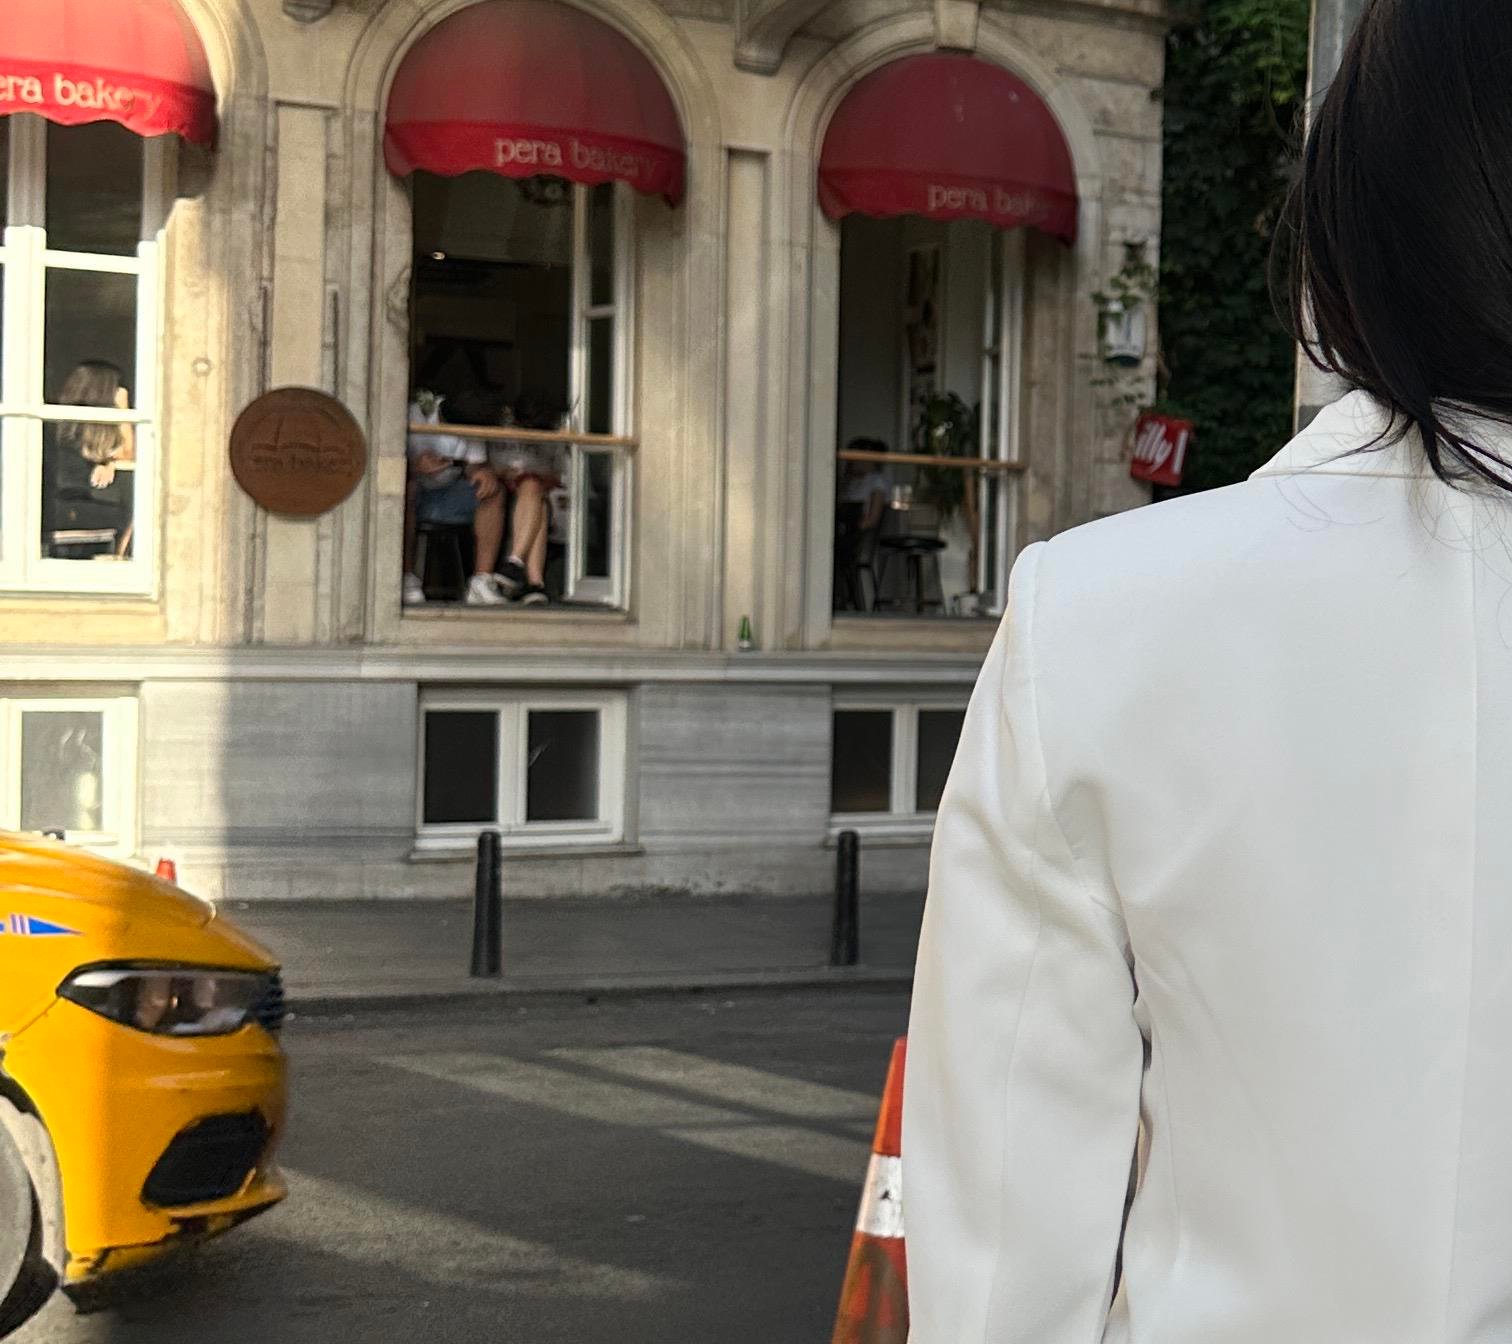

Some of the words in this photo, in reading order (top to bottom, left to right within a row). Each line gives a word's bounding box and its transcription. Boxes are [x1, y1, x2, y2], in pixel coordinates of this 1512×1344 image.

[0, 73, 45, 104] era
[495, 138, 563, 167] pera
[927, 184, 989, 212] pera
